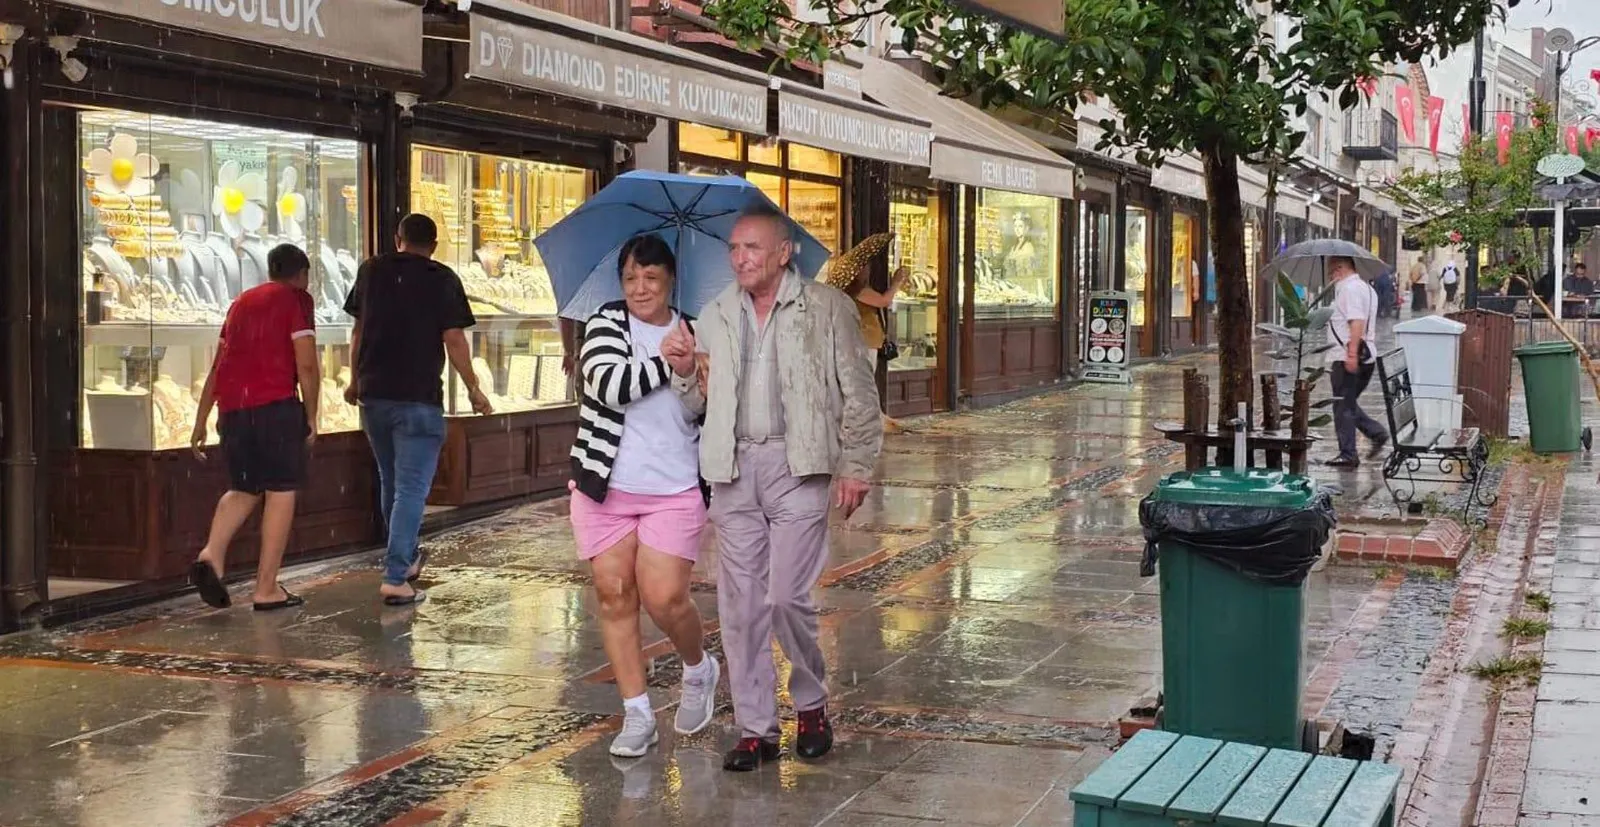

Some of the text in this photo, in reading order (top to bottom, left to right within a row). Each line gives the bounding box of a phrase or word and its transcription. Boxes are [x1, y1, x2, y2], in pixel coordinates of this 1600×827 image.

[160, 0, 325, 38] ULUK
[522, 41, 605, 92] DIAMOND
[614, 64, 671, 106] EDİRNE
[678, 80, 764, 124] KUYUMCUSU
[819, 109, 887, 149] KUYUMCULUK
